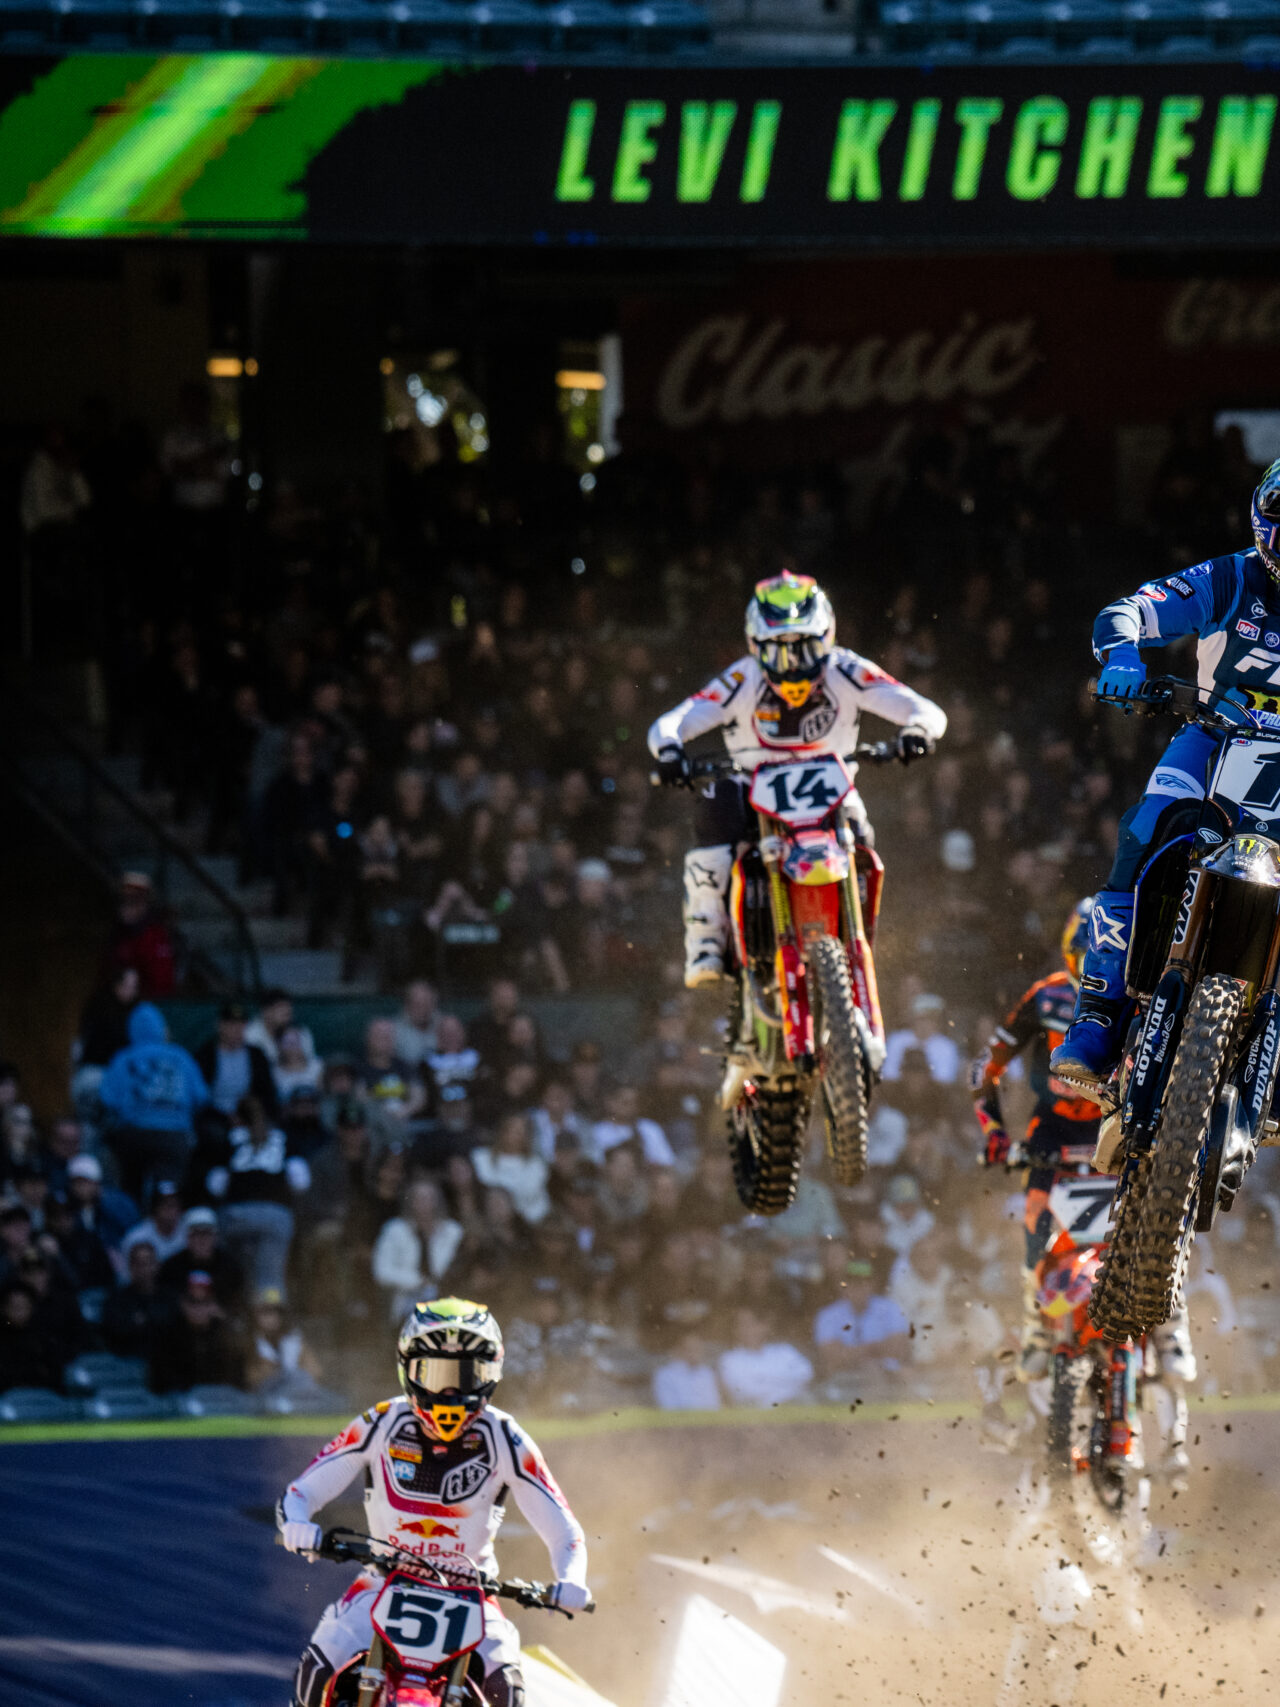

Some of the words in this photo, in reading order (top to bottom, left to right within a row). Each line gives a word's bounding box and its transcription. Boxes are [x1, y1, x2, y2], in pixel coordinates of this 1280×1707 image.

[555, 98, 783, 203] LEVI
[829, 95, 1279, 203] KITCHEN
[656, 310, 1046, 430] Classic
[766, 767, 839, 813] 14
[1135, 995, 1168, 1087] DUNLOP
[1252, 1018, 1278, 1115] DUNLOP
[1067, 1187, 1113, 1232] 7
[387, 1534, 425, 1557] Red
[427, 1542, 467, 1559] Bull
[384, 1591, 470, 1655] 51
